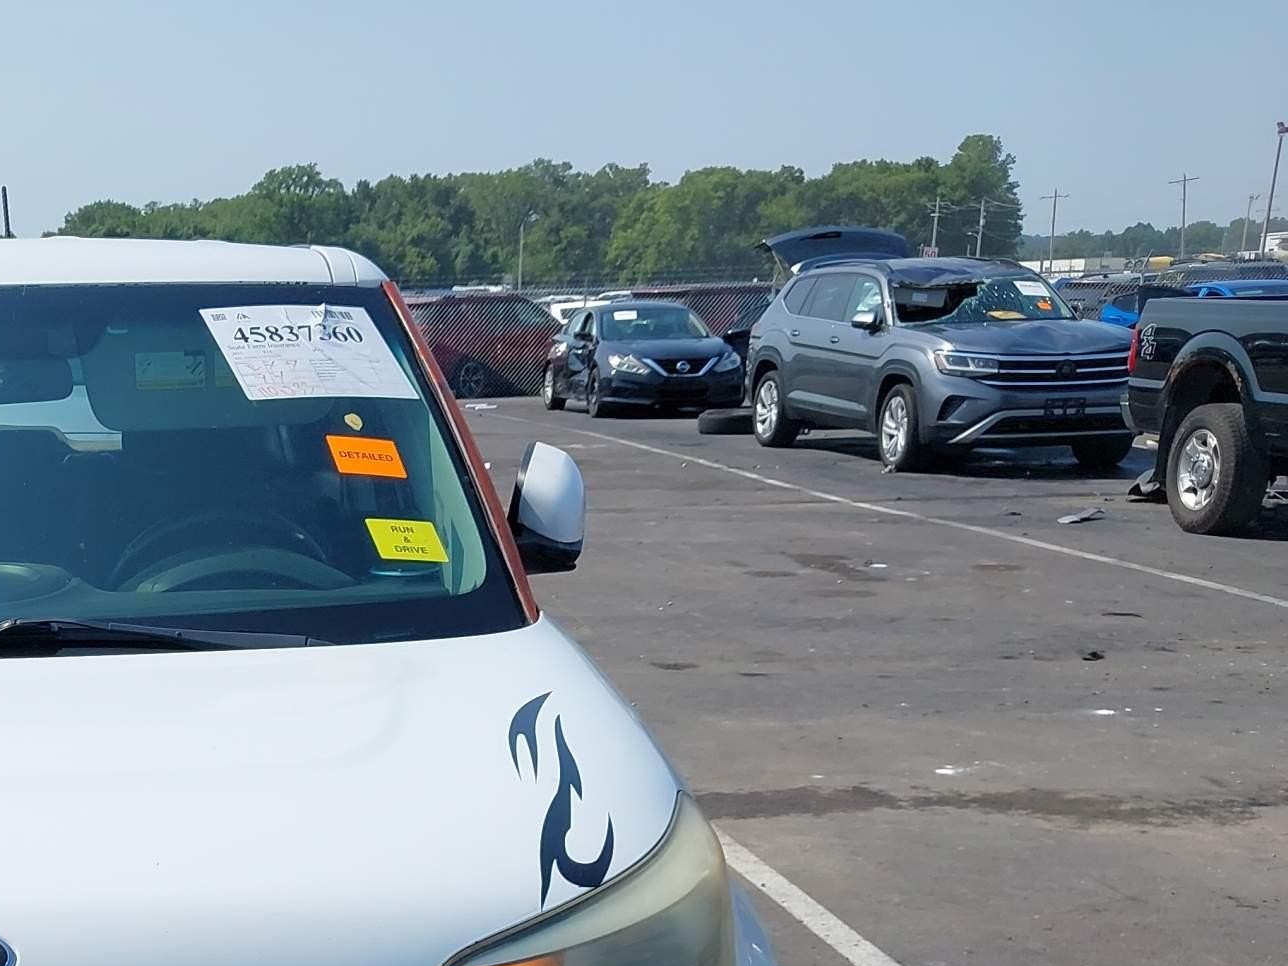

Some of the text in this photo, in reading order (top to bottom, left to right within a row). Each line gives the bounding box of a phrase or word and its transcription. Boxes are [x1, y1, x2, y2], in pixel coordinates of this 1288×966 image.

[233, 323, 364, 343] 45837360
[338, 450, 394, 462] DETAILED
[390, 525, 415, 534] RUN
[403, 535, 412, 543] &
[394, 545, 429, 554] DRIVE
